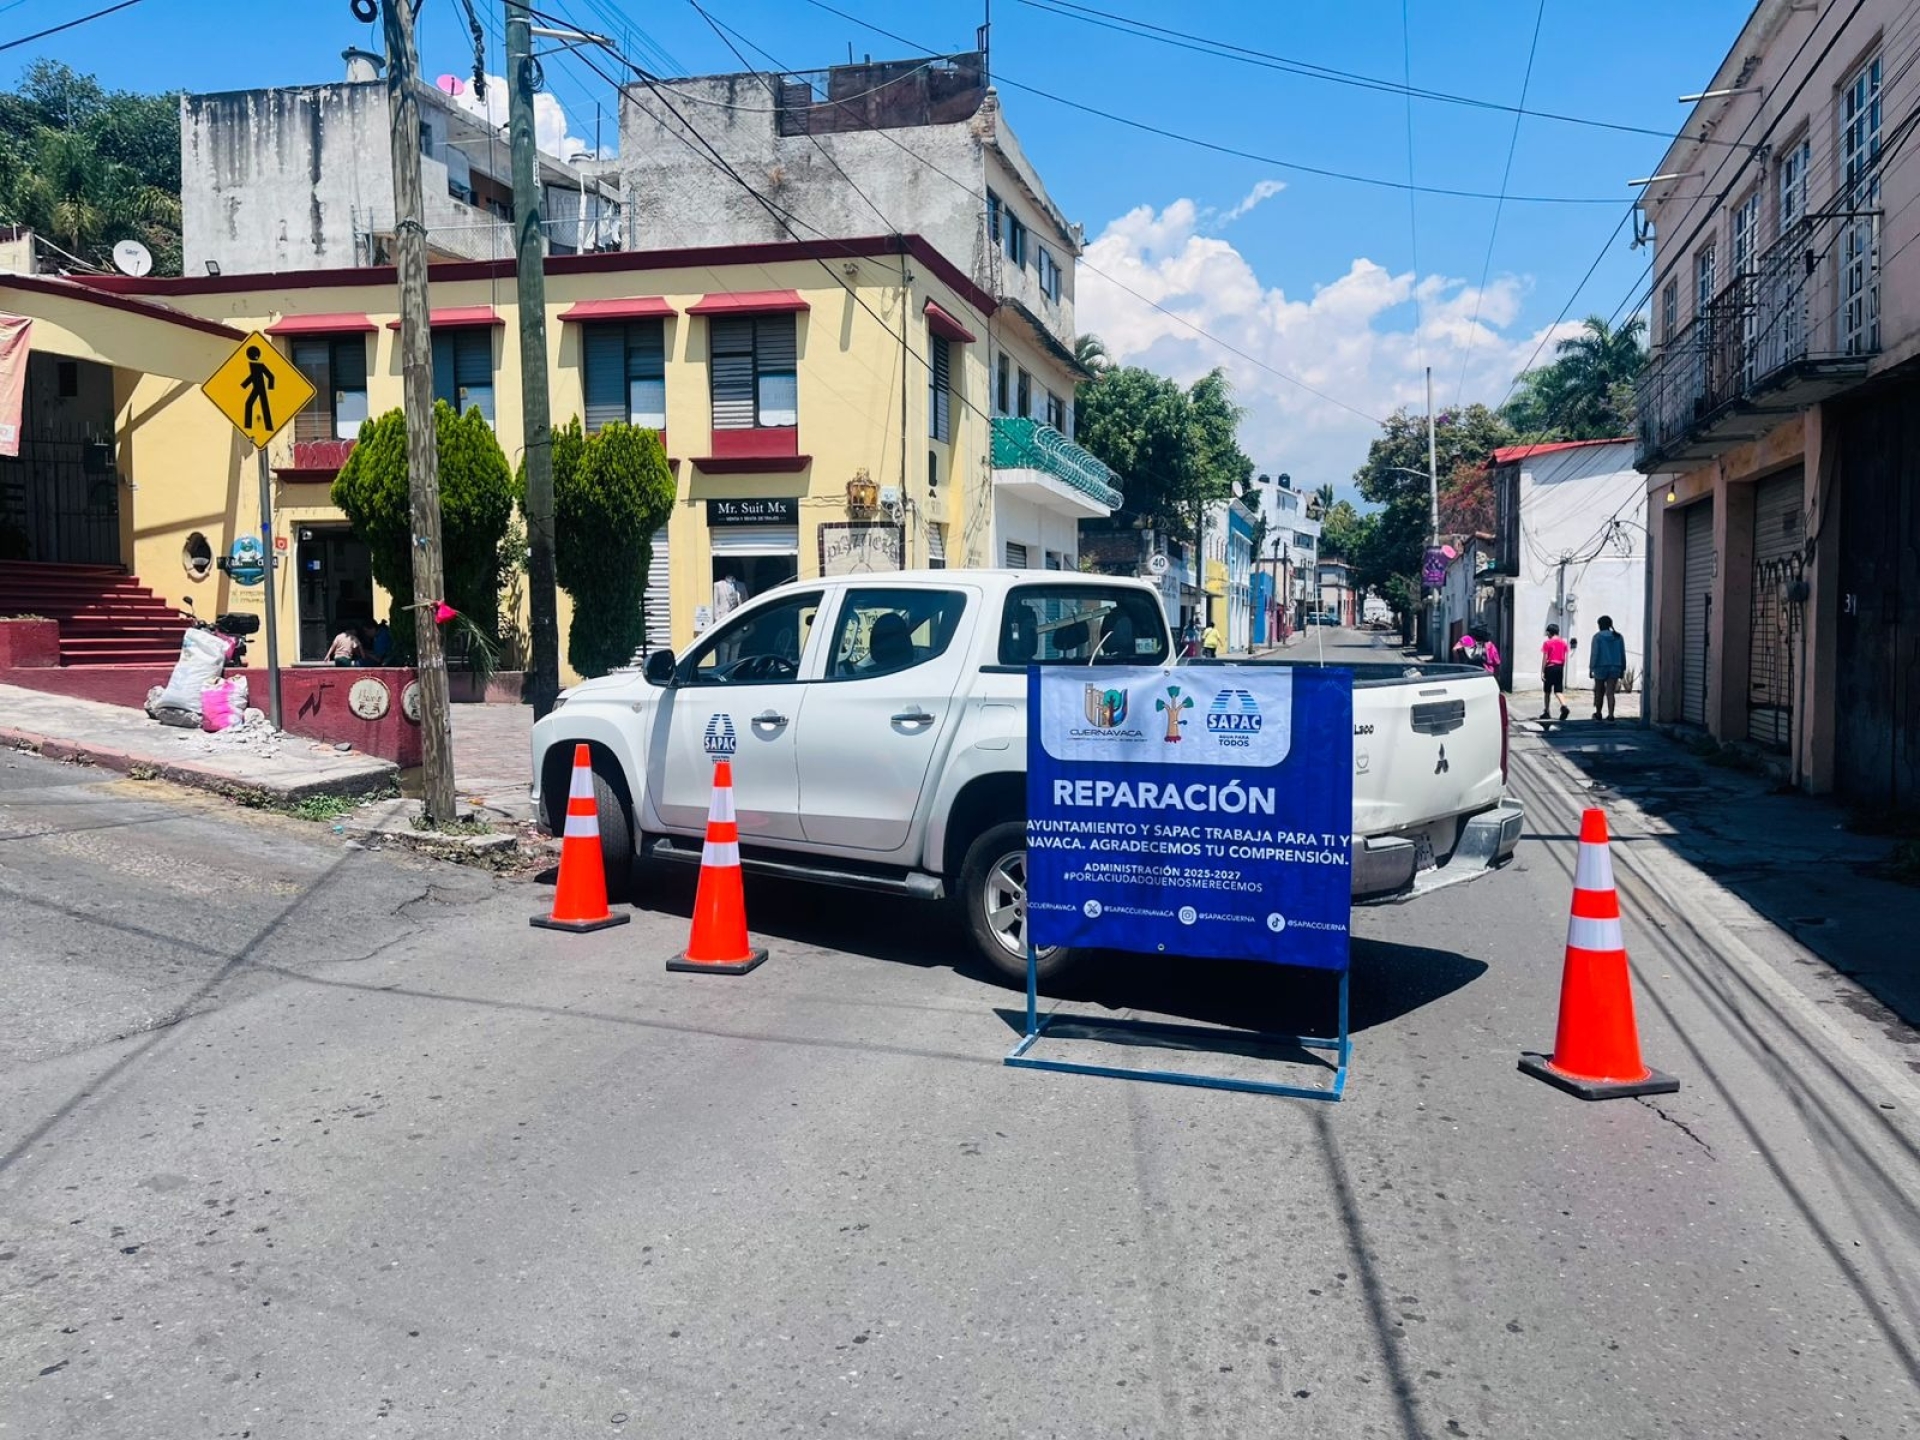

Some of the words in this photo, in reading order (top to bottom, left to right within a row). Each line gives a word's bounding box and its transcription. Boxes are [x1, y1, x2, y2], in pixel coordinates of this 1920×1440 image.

[718, 502, 737, 514] Mr.
[741, 502, 763, 514] Suit
[767, 501, 787, 513] Mx
[1153, 557, 1165, 567] 40
[1208, 714, 1261, 729] SAPAC
[1069, 729, 1143, 737] CUERNAVACA
[705, 737, 735, 750] SAPAC
[1053, 779, 1276, 815] REPARACIÓN
[1026, 819, 1137, 835] AYUNTAMIENTO
[1141, 824, 1150, 836] Y
[1154, 825, 1200, 839] SAPAC
[1205, 827, 1273, 842] TRABAJA
[1277, 831, 1317, 846] PARA
[1321, 834, 1335, 847] TI
[1340, 835, 1350, 847] Y
[1090, 839, 1201, 855] AGRADECEMOS
[1205, 844, 1225, 857] TU
[1229, 845, 1349, 866] COMPRENSIÓN.
[1084, 863, 1181, 876] ADMINISTRACIÓN
[1183, 868, 1241, 880] 2025-2027
[1063, 872, 1263, 893] #PORLACIUDADQUENOSMERECEMOS
[1198, 912, 1256, 923] @SAPACCUERNA
[1287, 919, 1347, 932] @SAPACCUERNA
